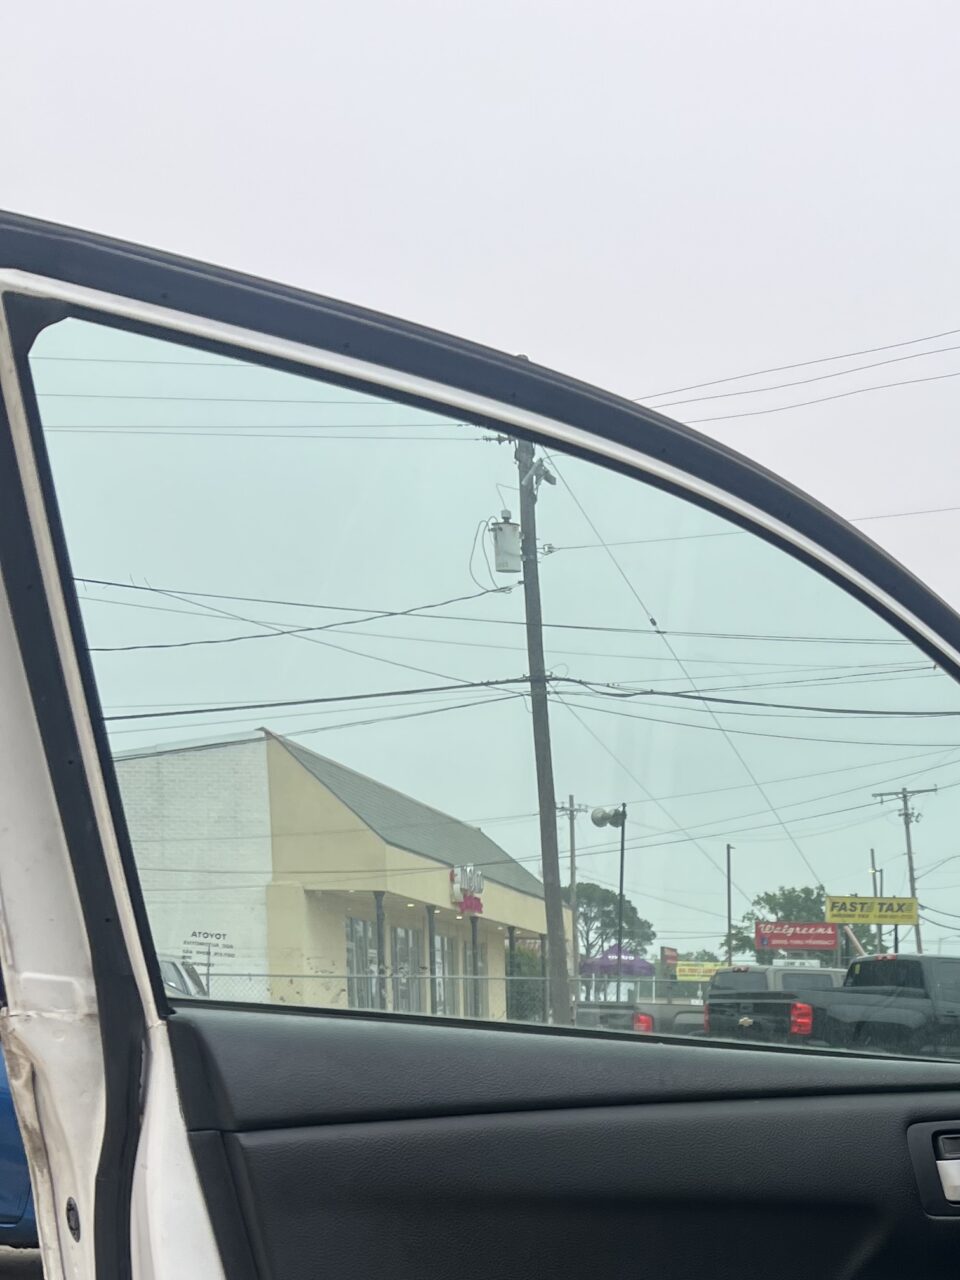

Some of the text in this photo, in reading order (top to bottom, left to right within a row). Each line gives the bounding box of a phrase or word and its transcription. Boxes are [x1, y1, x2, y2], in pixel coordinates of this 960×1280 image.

[831, 901, 906, 913] FAST TAX
[759, 923, 836, 937] Walgreens
